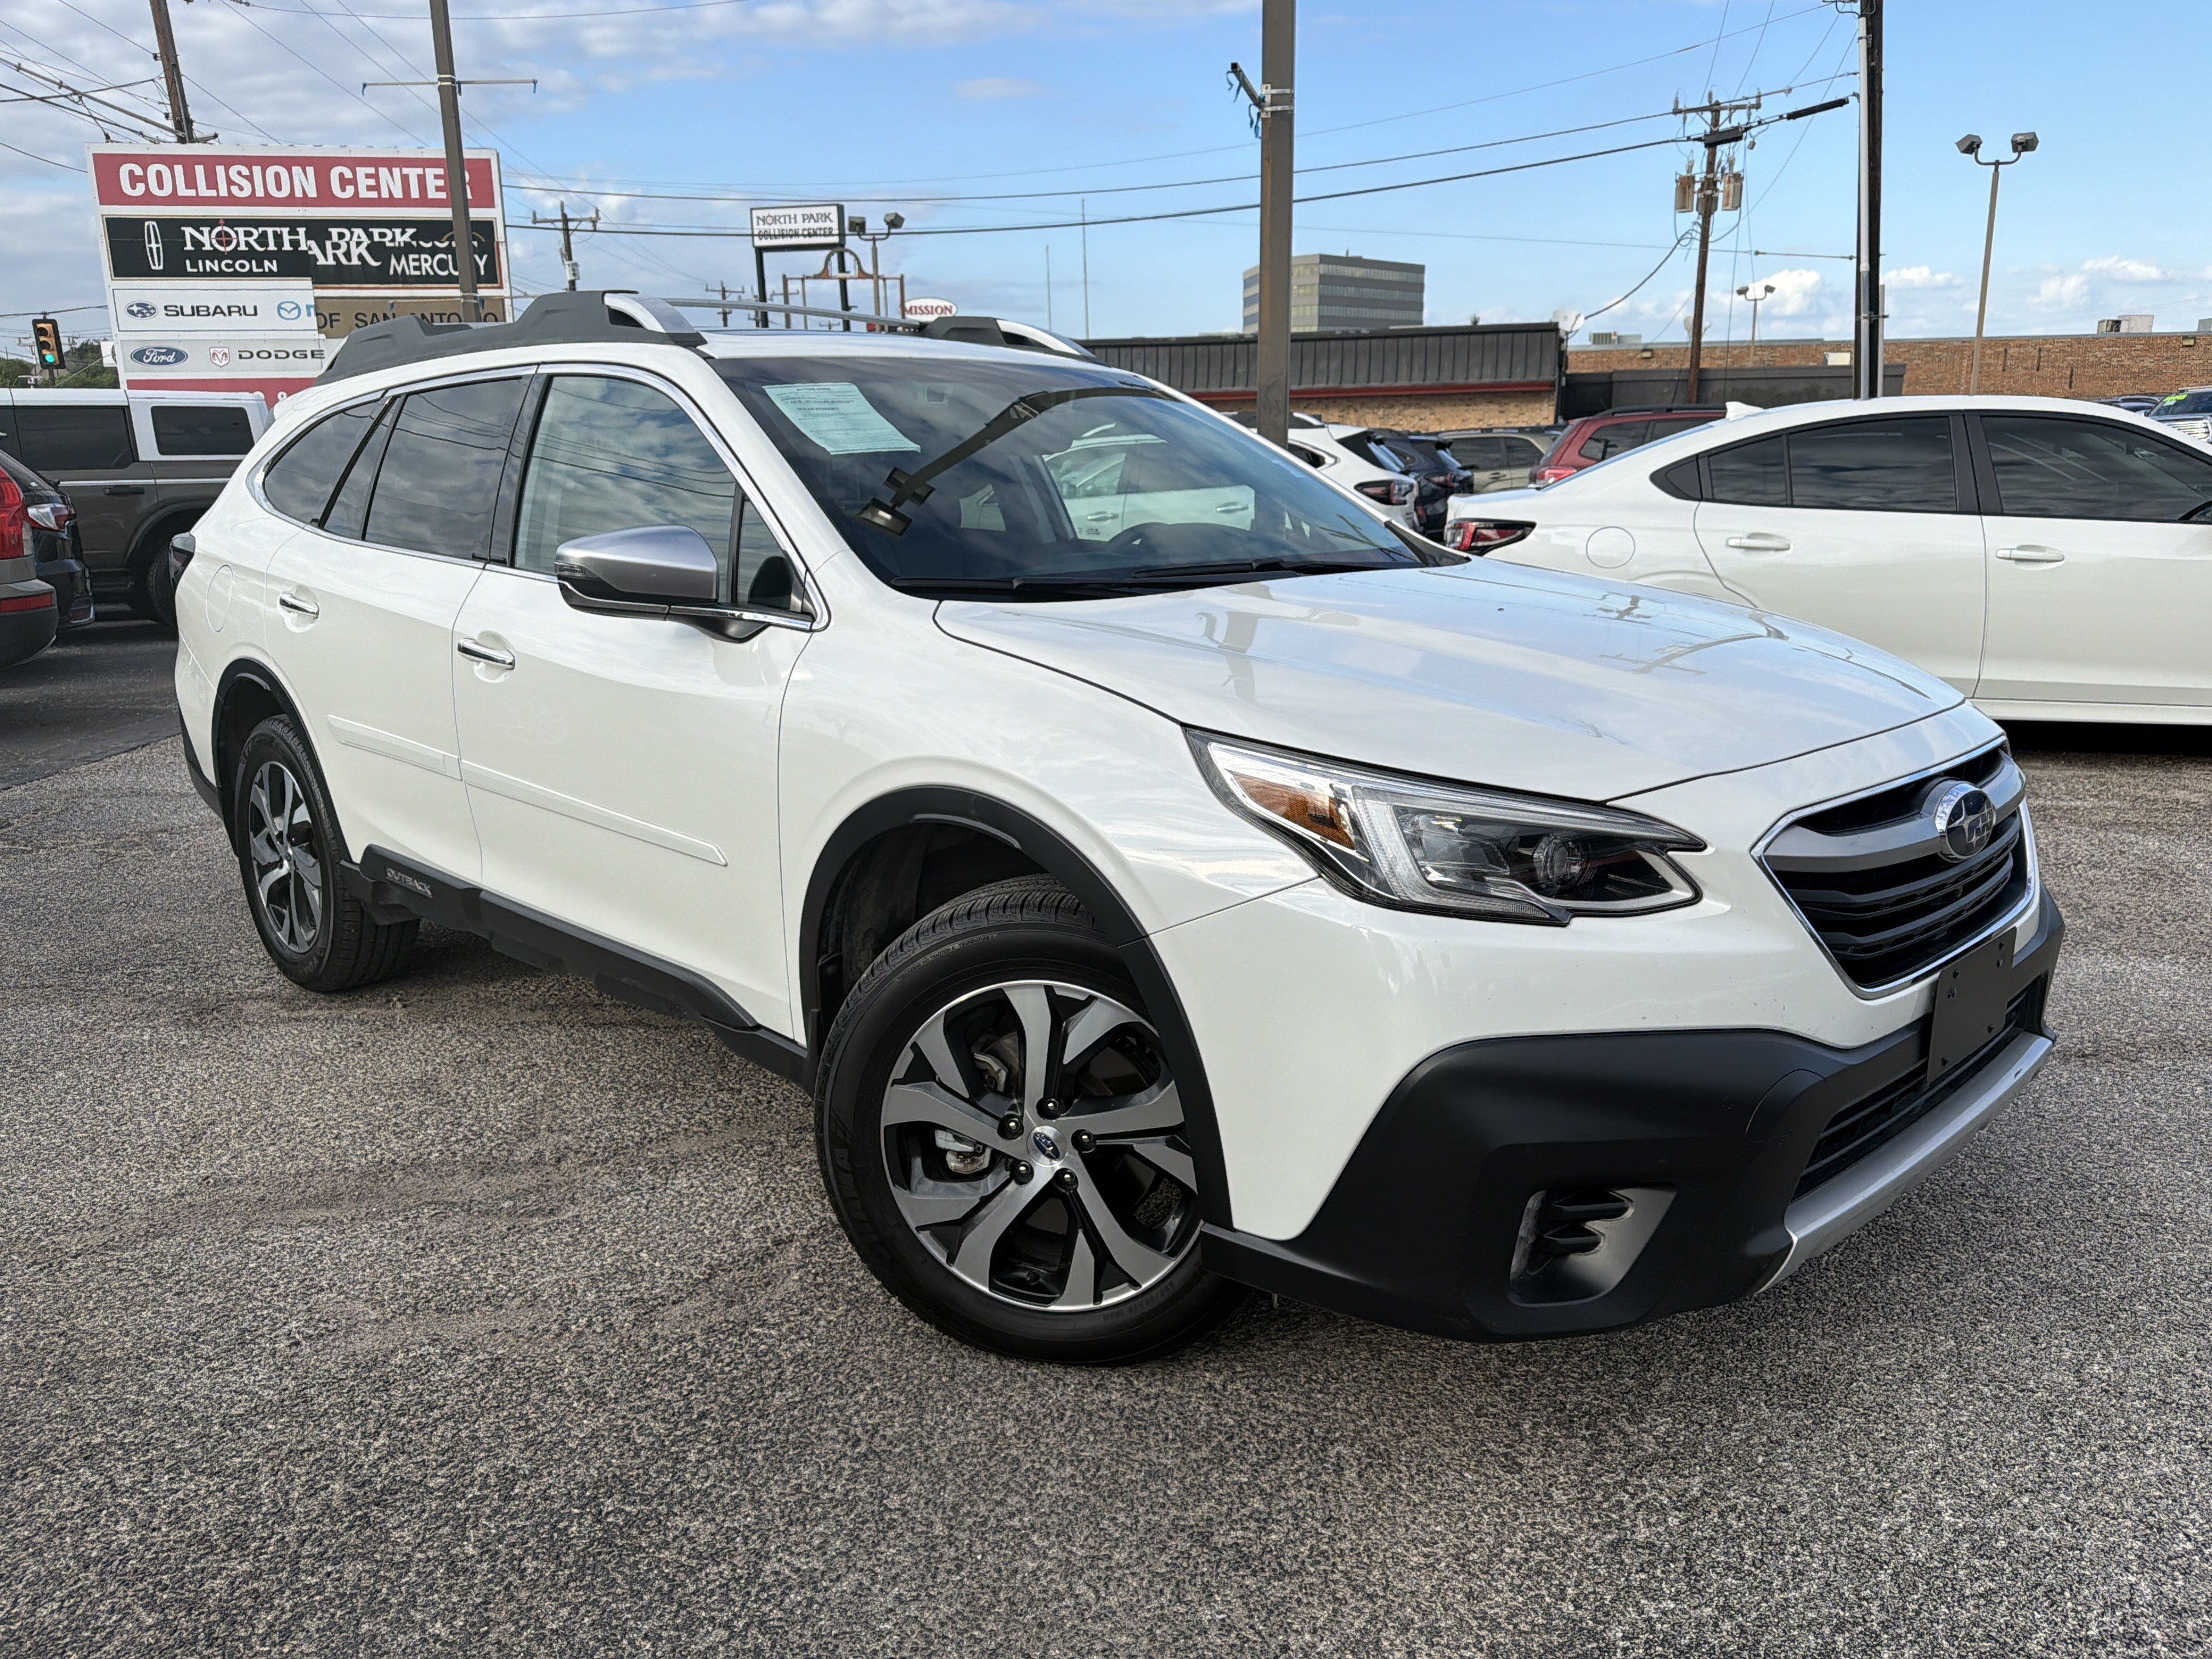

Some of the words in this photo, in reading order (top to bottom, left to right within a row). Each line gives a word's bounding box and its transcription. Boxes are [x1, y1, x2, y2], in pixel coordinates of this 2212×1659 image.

[119, 163, 318, 199] COLLISION
[755, 213, 798, 226] NORTH
[802, 212, 833, 224] PARK
[180, 225, 308, 252] NORTH
[758, 228, 800, 240] COLLISION
[802, 227, 833, 238] CENTER
[185, 259, 278, 272] LINCOLN
[389, 253, 488, 275] MERCUY
[163, 305, 258, 317] SUBARU
[143, 348, 176, 363] Ford
[238, 349, 326, 360] DODGE
[387, 868, 432, 895] OUTBACK
